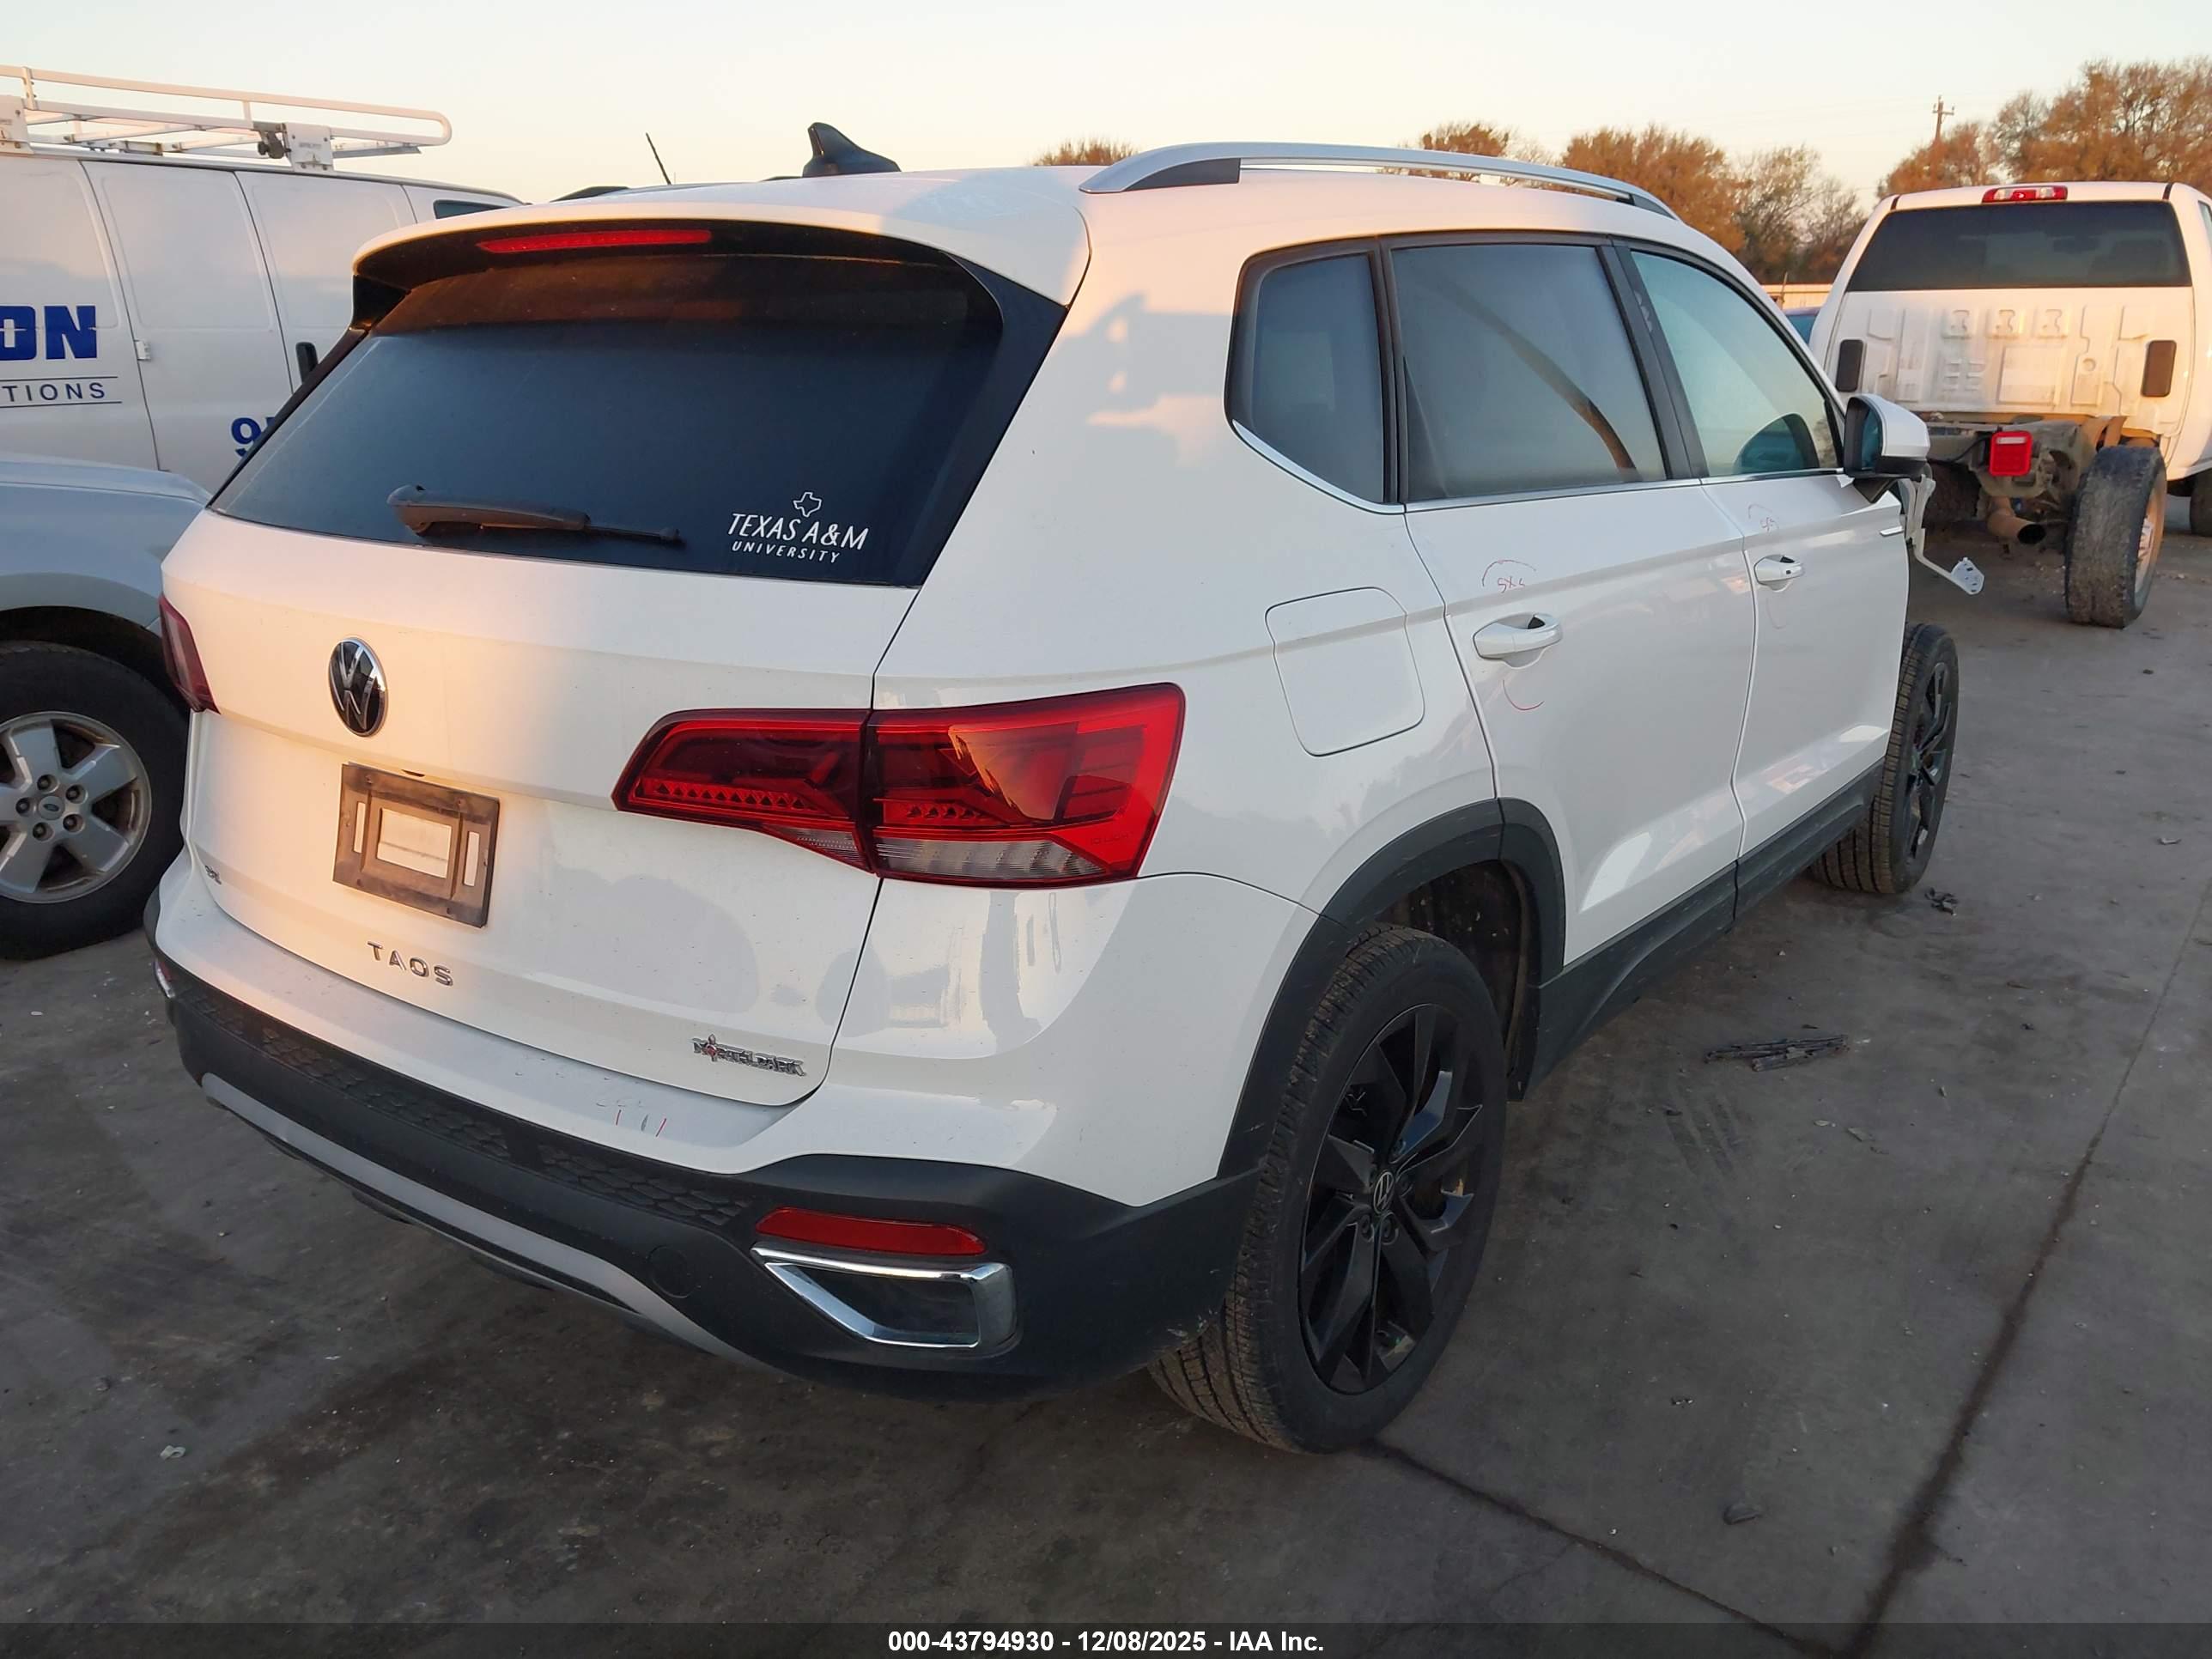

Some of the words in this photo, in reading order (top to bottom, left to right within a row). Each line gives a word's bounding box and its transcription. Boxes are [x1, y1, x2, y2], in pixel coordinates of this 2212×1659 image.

[2, 382, 105, 402] TIONS
[230, 416, 276, 458] 9
[728, 513, 801, 541] TEXAS
[801, 521, 869, 550] A&M
[732, 540, 840, 563] UNIVERSITY
[367, 941, 453, 987] TAOS
